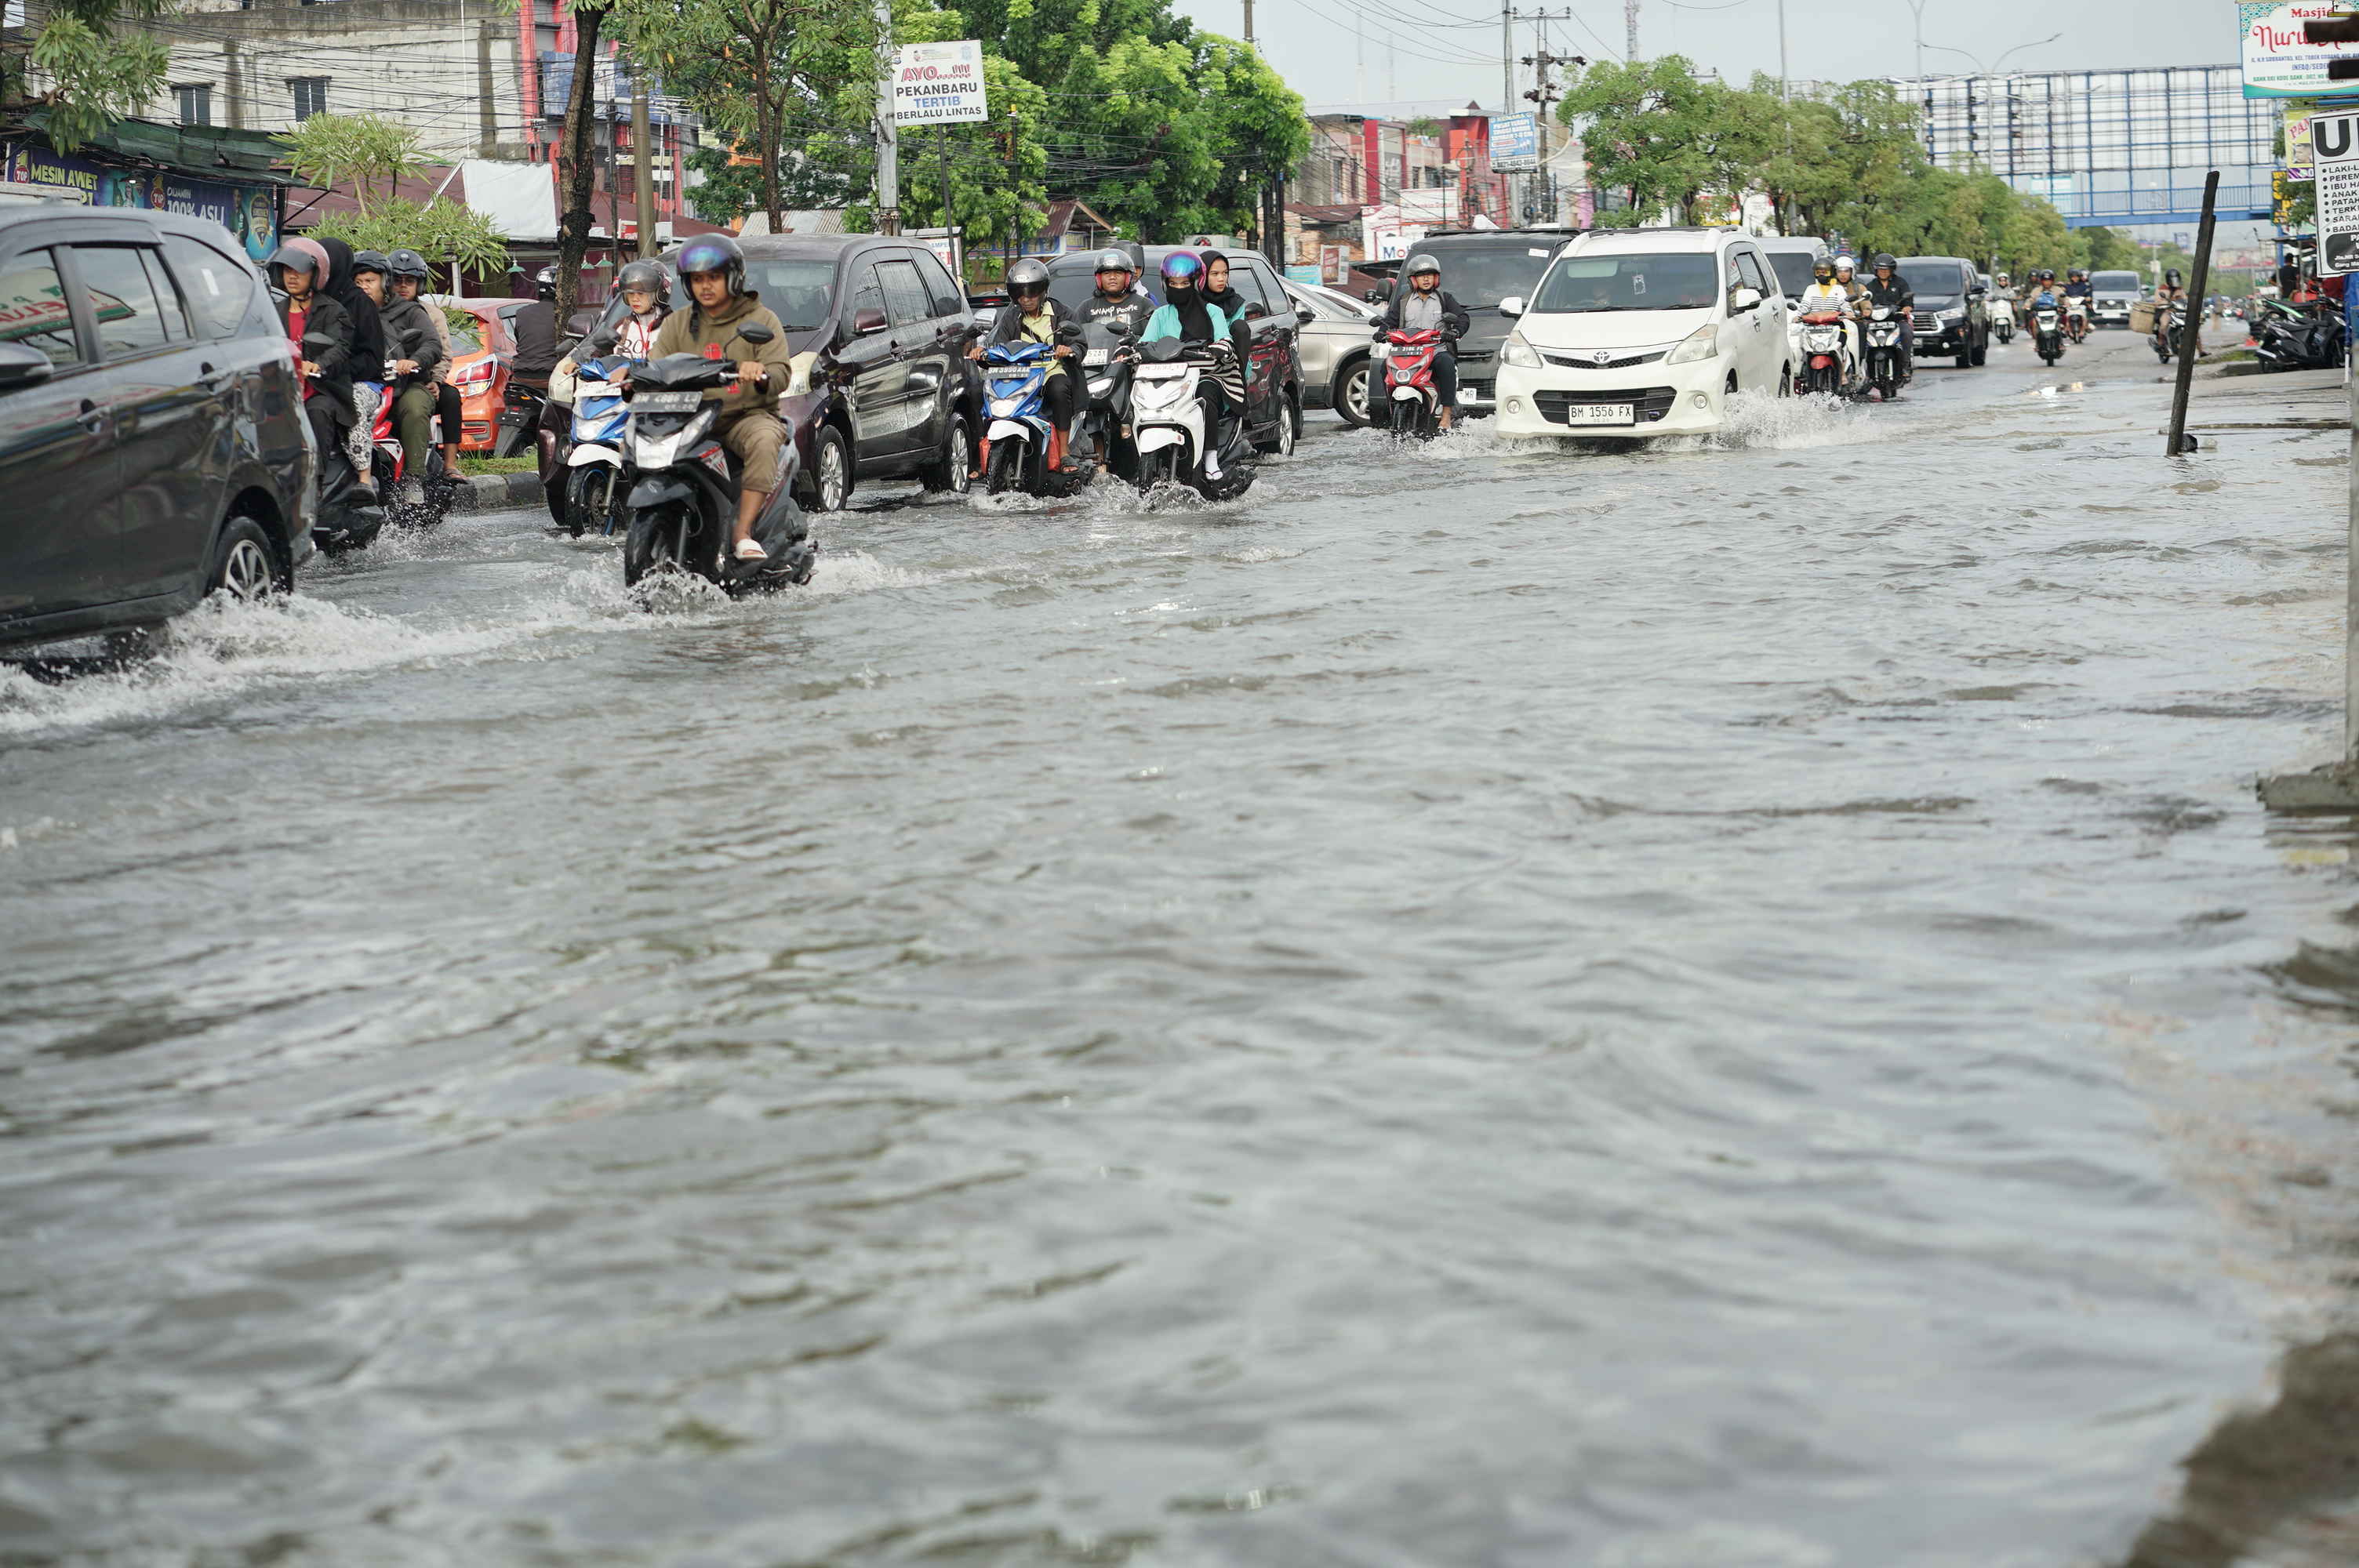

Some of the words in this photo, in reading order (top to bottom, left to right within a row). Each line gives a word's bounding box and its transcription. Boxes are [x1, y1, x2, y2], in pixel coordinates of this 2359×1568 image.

[896, 82, 977, 97] PEKANBARU
[914, 96, 961, 108] TERTIB
[896, 109, 943, 120] BERLALU
[946, 107, 982, 116] LINTAS
[2314, 118, 2359, 157] U
[16, 170, 28, 181] TOP
[31, 163, 65, 184] MESIN
[67, 169, 98, 191] AWET
[167, 200, 196, 216] 100%
[199, 205, 225, 225] ASLI
[2332, 205, 2359, 214] TERK
[2333, 224, 2359, 233] BADA
[1571, 408, 1584, 417] BM
[1589, 406, 1614, 417] 1556
[1619, 406, 1632, 416] FX
